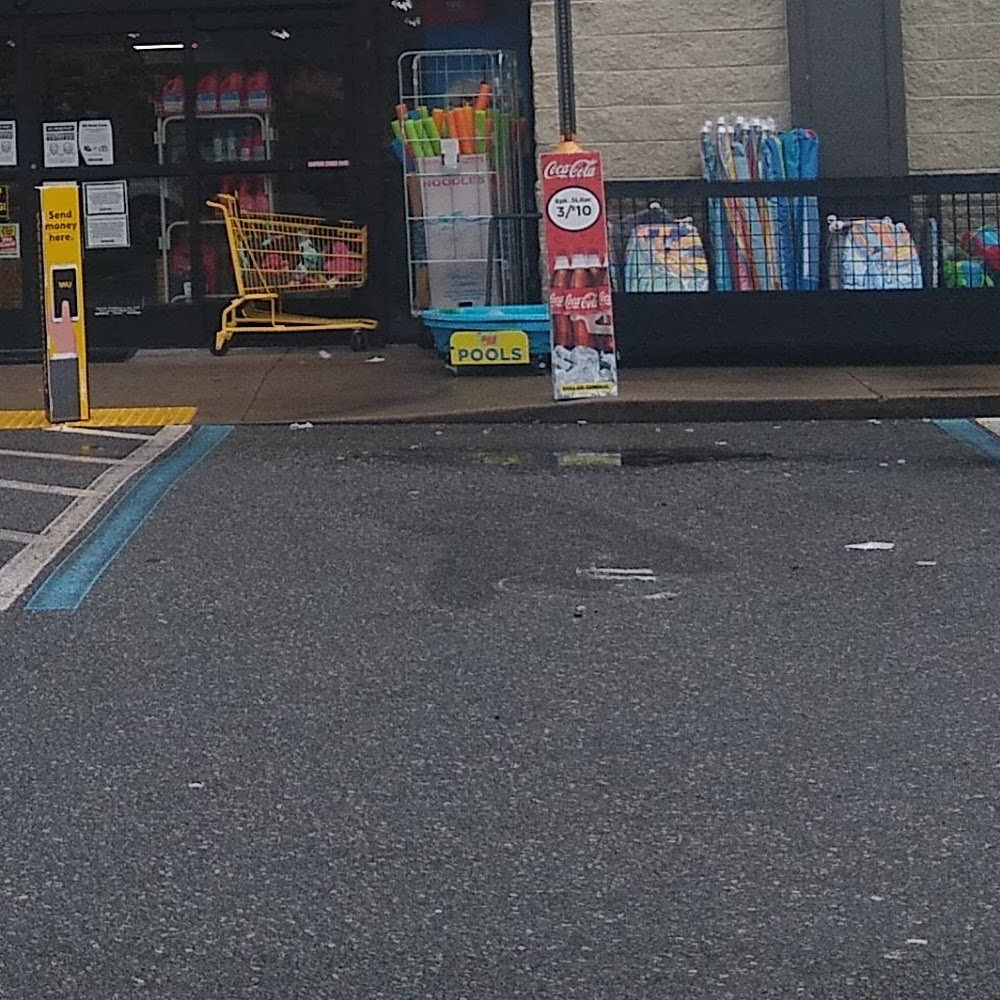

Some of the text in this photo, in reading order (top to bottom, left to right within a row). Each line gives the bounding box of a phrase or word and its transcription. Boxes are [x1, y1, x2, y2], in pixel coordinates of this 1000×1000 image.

[48, 210, 73, 219] Send
[45, 221, 77, 231] money
[49, 234, 74, 242] here.
[57, 280, 73, 289] WU
[457, 347, 522, 362] POOLS
